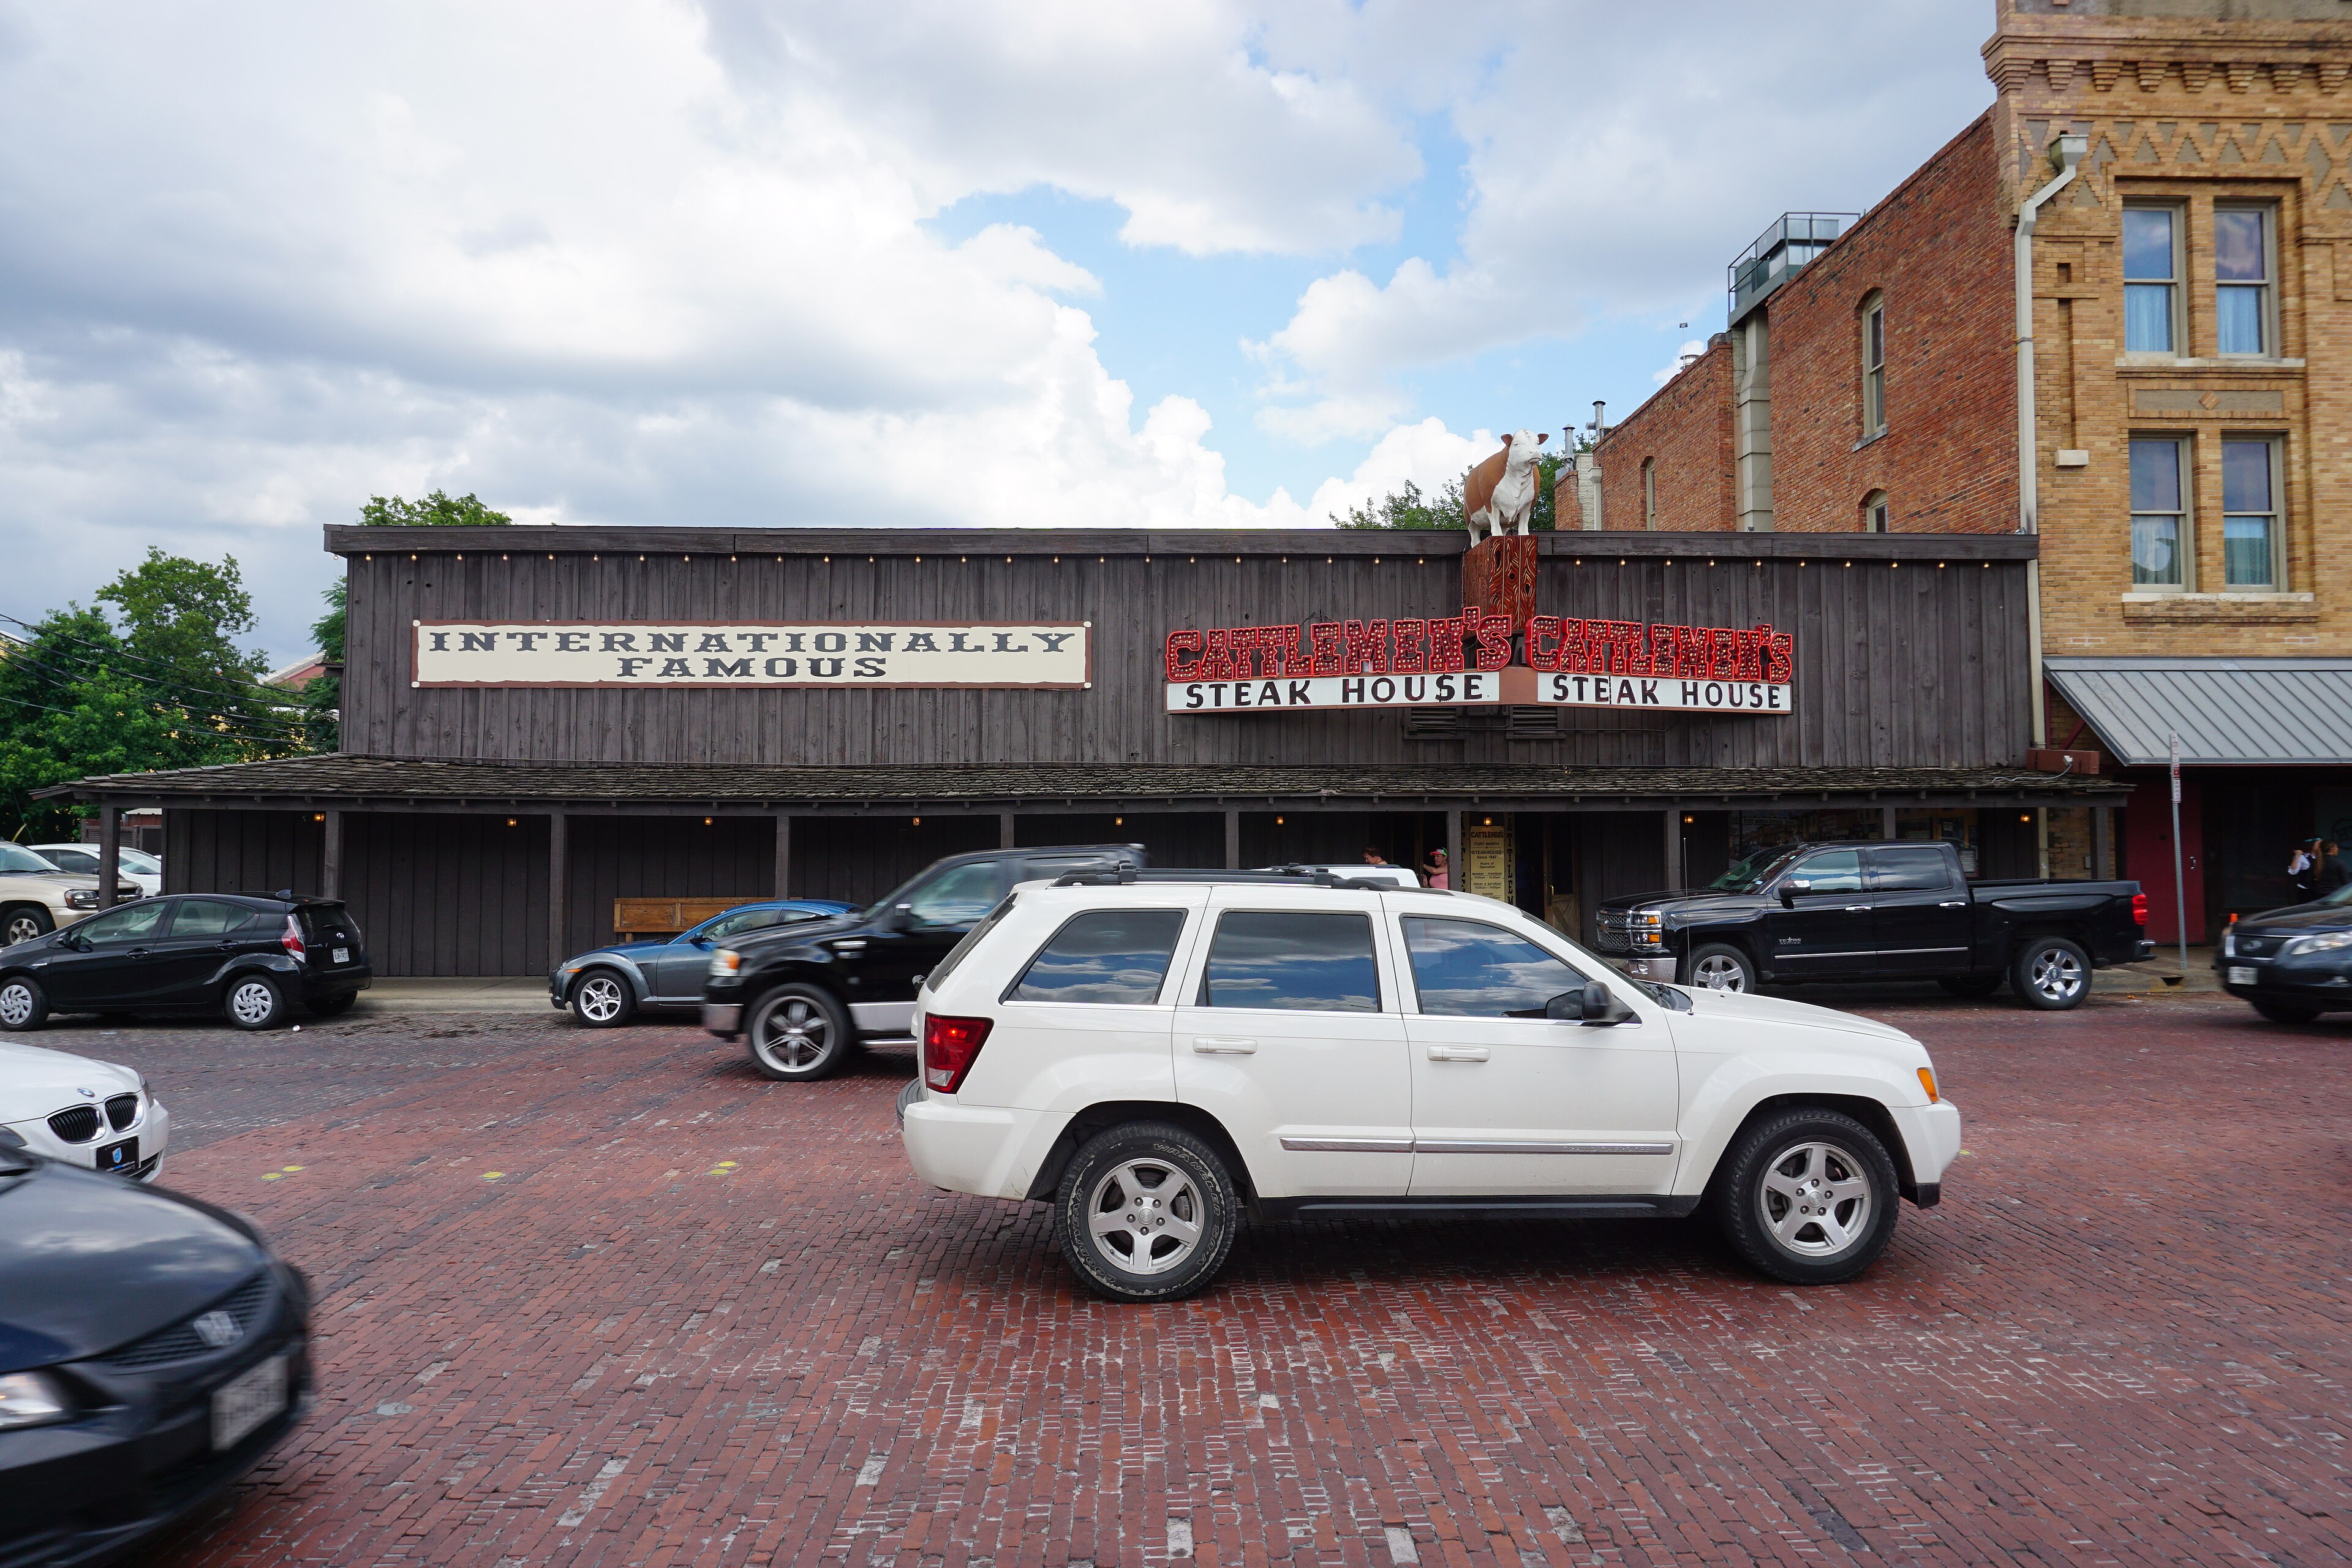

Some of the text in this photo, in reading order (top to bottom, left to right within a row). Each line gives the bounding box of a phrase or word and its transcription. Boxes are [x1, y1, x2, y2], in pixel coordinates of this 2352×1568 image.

[429, 631, 1076, 654] INTERNATIONALLY
[616, 657, 888, 678] FAMOUS
[1166, 606, 1512, 682] CATTLEMEN'S
[1525, 615, 1793, 684] CATTLEMEN'S
[1185, 673, 1483, 709] STEAK HOUSE
[1552, 674, 1781, 709] STEAK HOUSE
[1153, 1143, 1221, 1216] WRANGLER
[1072, 1188, 1117, 1283] GOODYEAR
